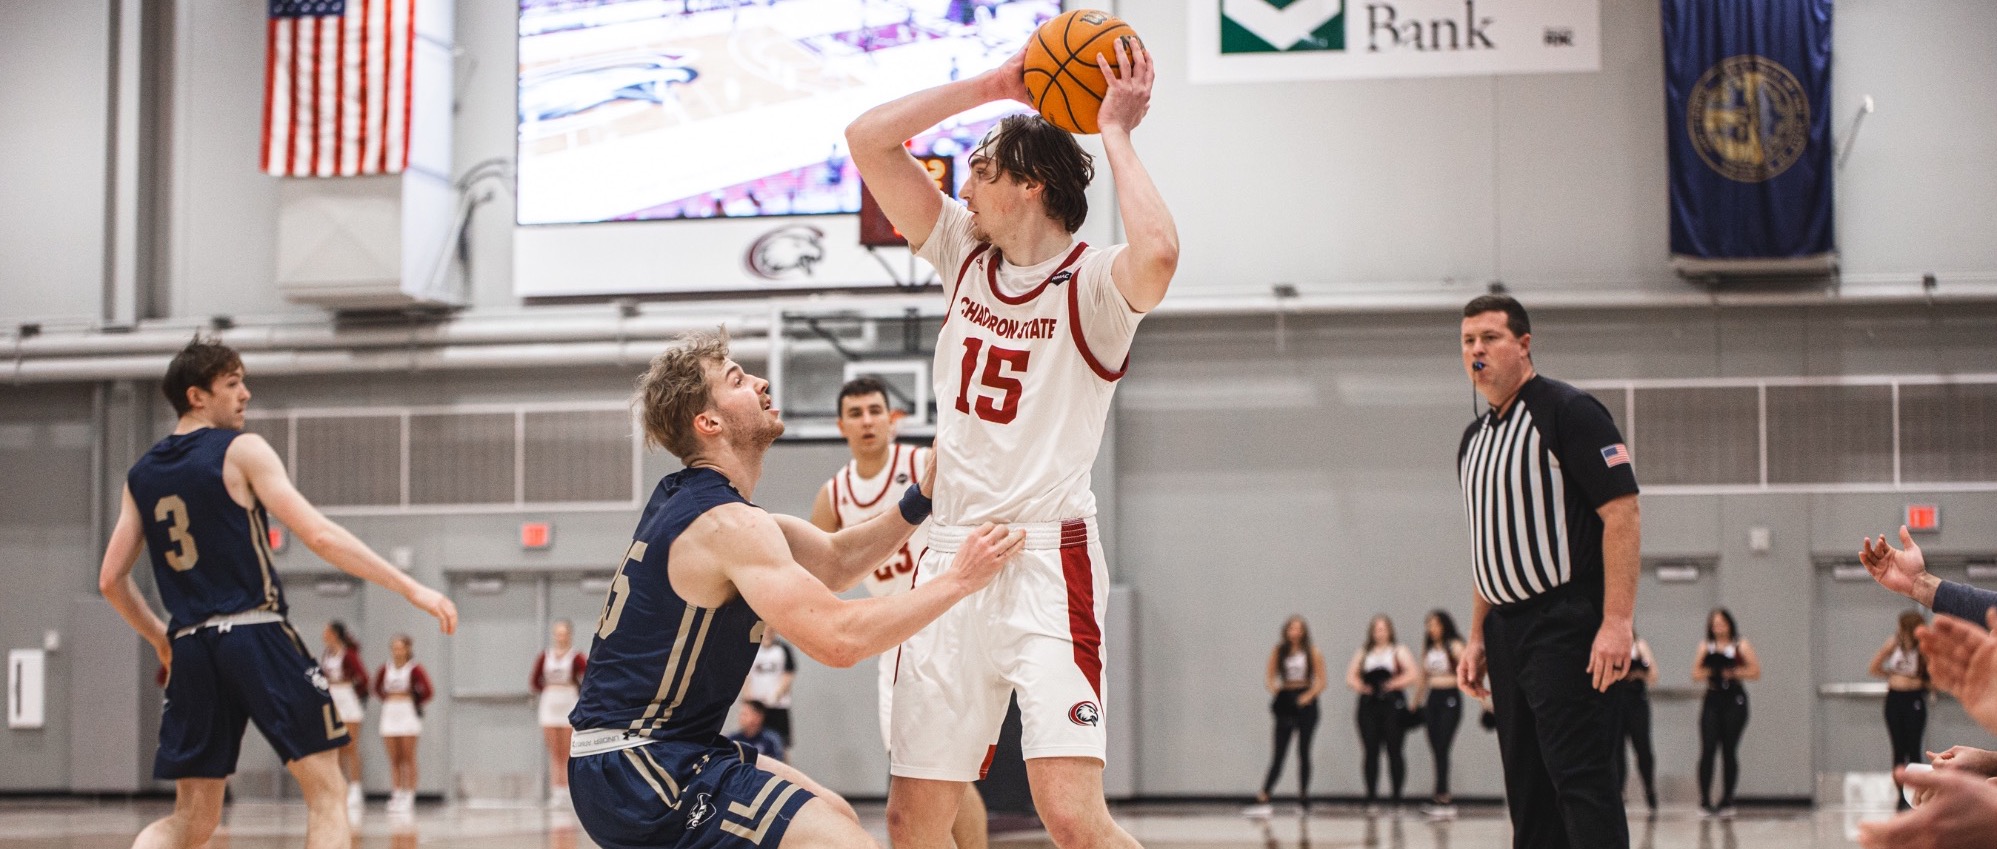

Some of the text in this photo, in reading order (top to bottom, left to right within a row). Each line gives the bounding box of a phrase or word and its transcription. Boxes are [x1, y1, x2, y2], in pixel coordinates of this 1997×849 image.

[1366, 0, 1495, 51] Bank
[961, 296, 1019, 339] CHADRON
[955, 337, 1031, 425] 15
[154, 494, 199, 572] 3
[595, 537, 648, 640] 5
